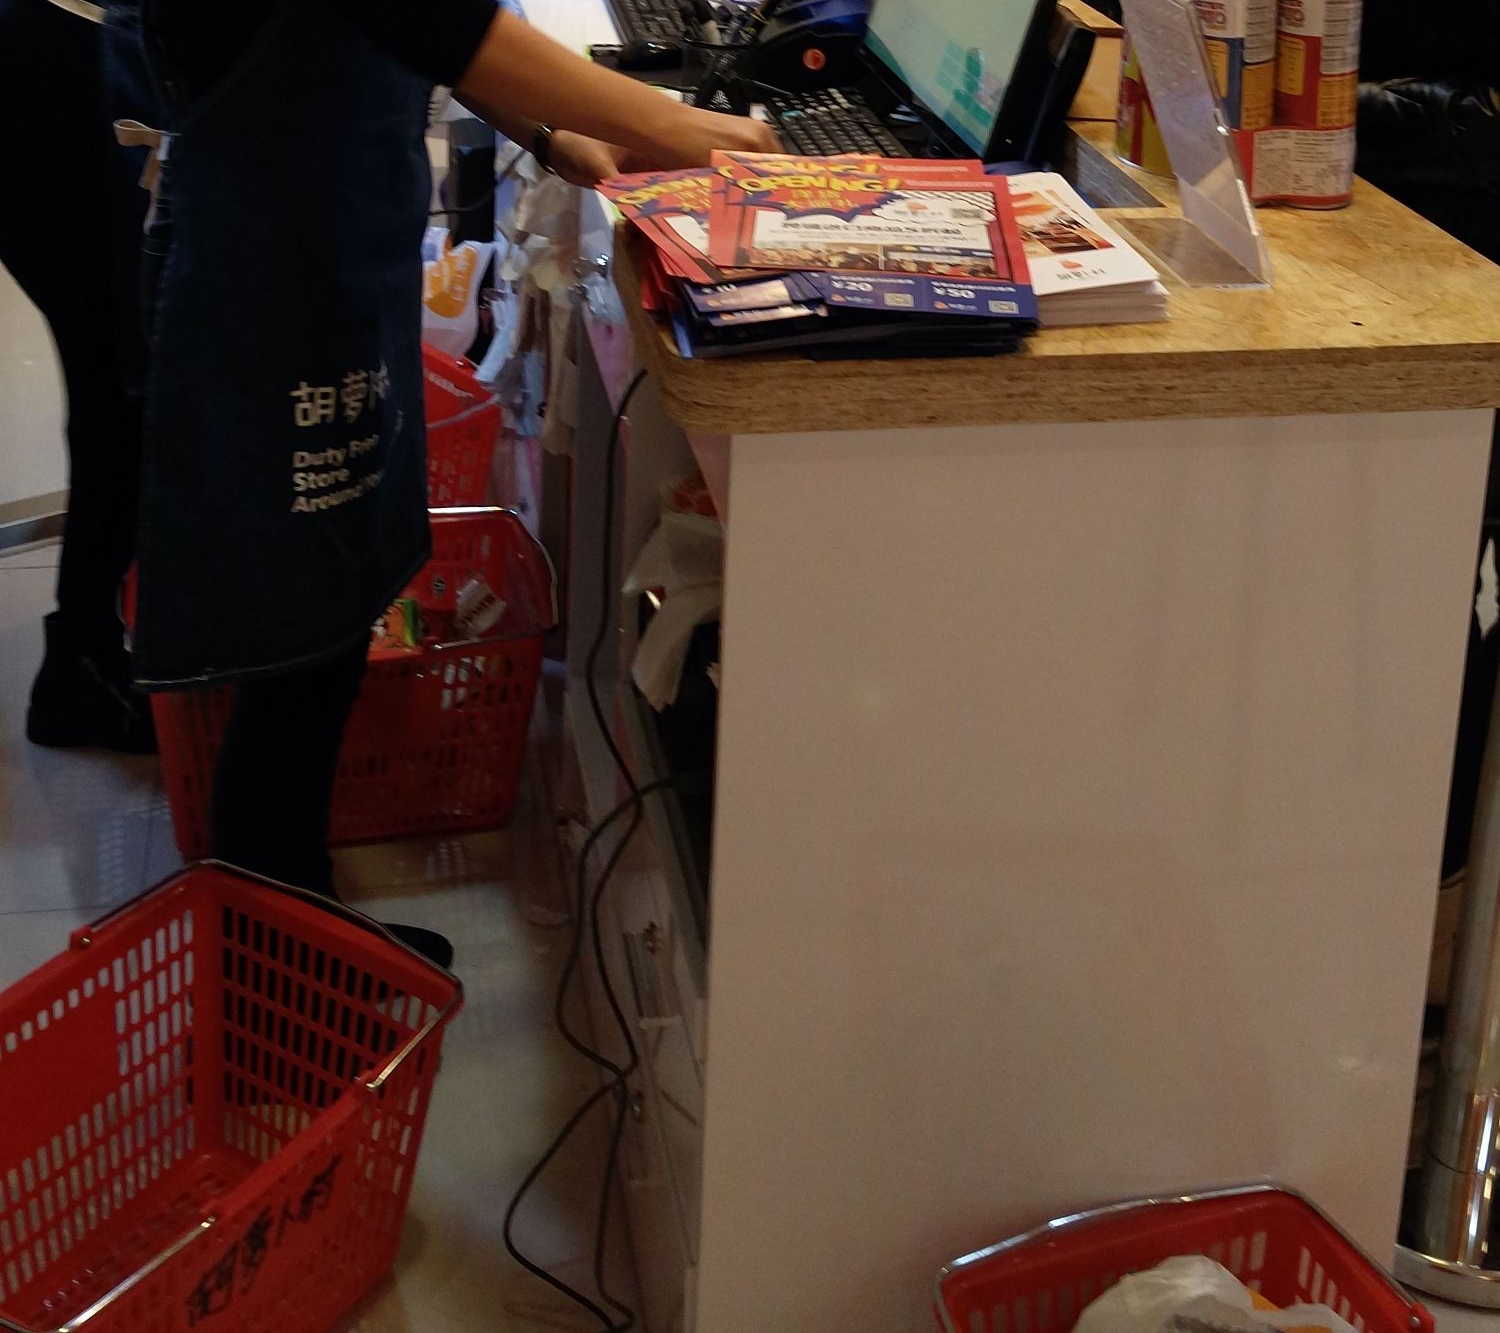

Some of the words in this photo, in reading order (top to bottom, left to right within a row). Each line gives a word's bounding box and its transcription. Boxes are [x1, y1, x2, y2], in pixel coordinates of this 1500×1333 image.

[736, 175, 902, 192] OPENING!
[292, 448, 347, 469] Duty
[292, 468, 351, 491] Store
